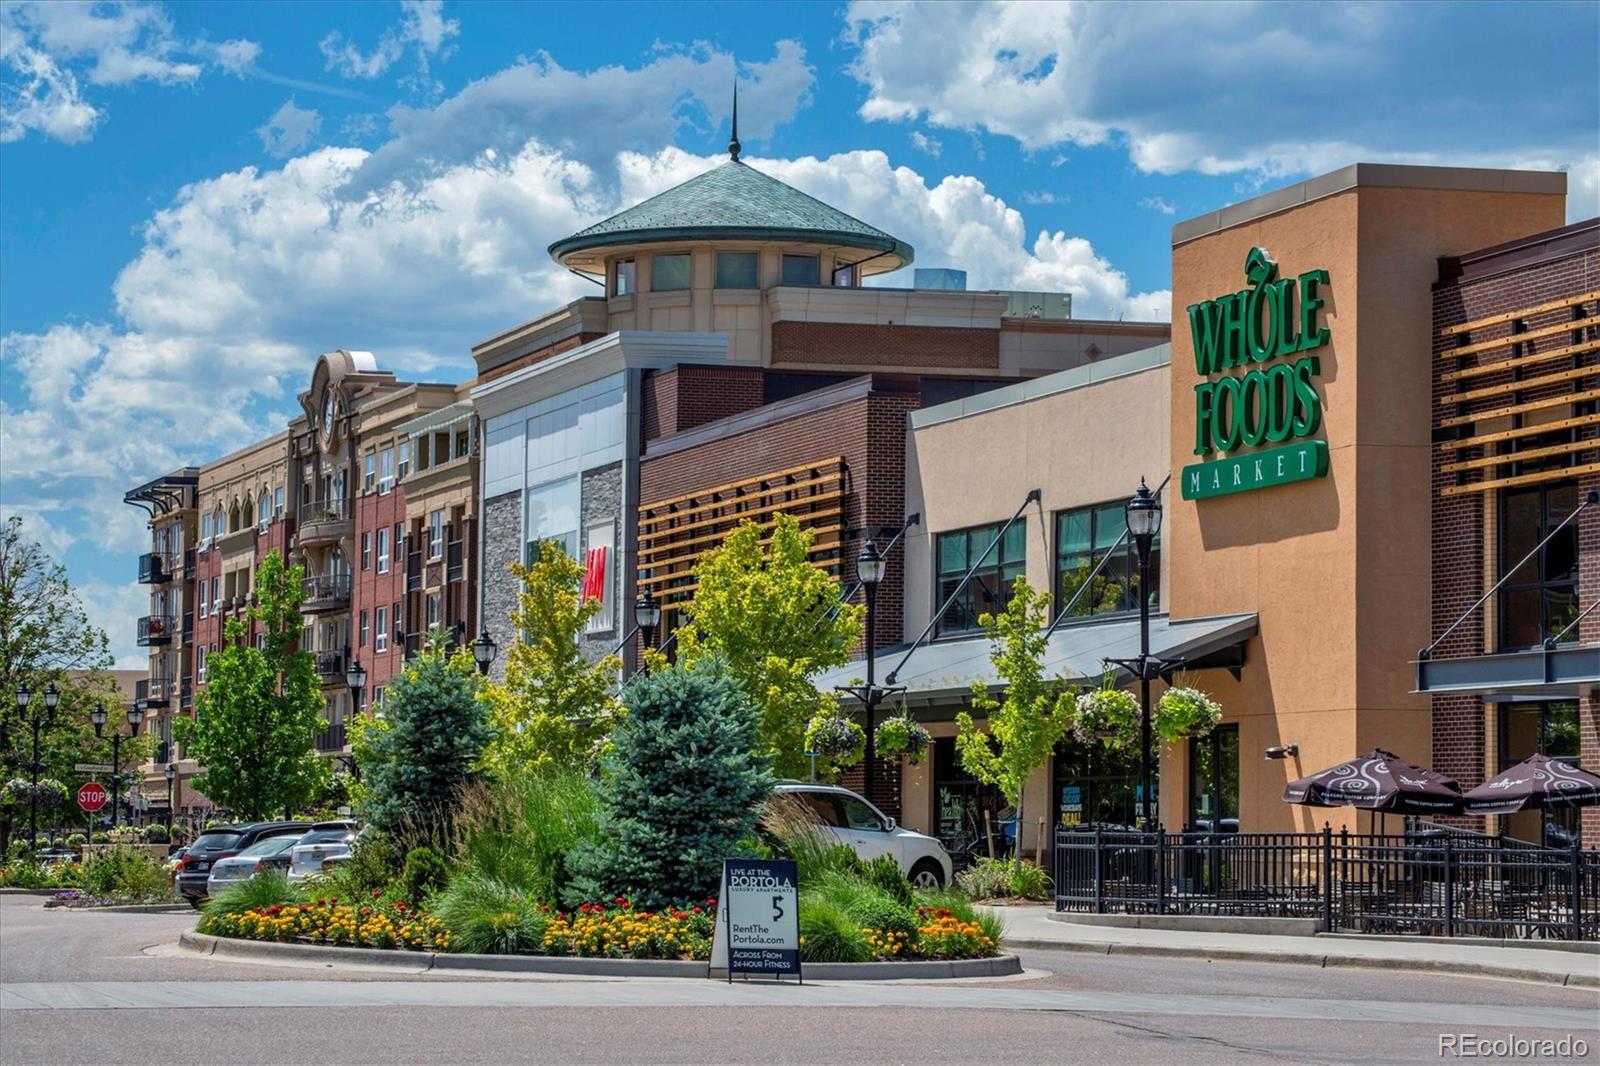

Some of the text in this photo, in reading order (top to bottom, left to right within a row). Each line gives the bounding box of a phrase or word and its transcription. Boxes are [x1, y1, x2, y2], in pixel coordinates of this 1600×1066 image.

[1187, 266, 1331, 375] WHOLE
[1194, 357, 1322, 455] FOODS
[1190, 450, 1308, 493] MARKET
[80, 791, 105, 803] STOP
[757, 869, 771, 877] THE
[731, 876, 792, 889] PORTOLA
[733, 924, 769, 934] RentThe
[733, 934, 785, 945] Portola.com
[733, 950, 783, 960] ACROSS FROM
[733, 960, 791, 969] 24-HOUR FITNESS
